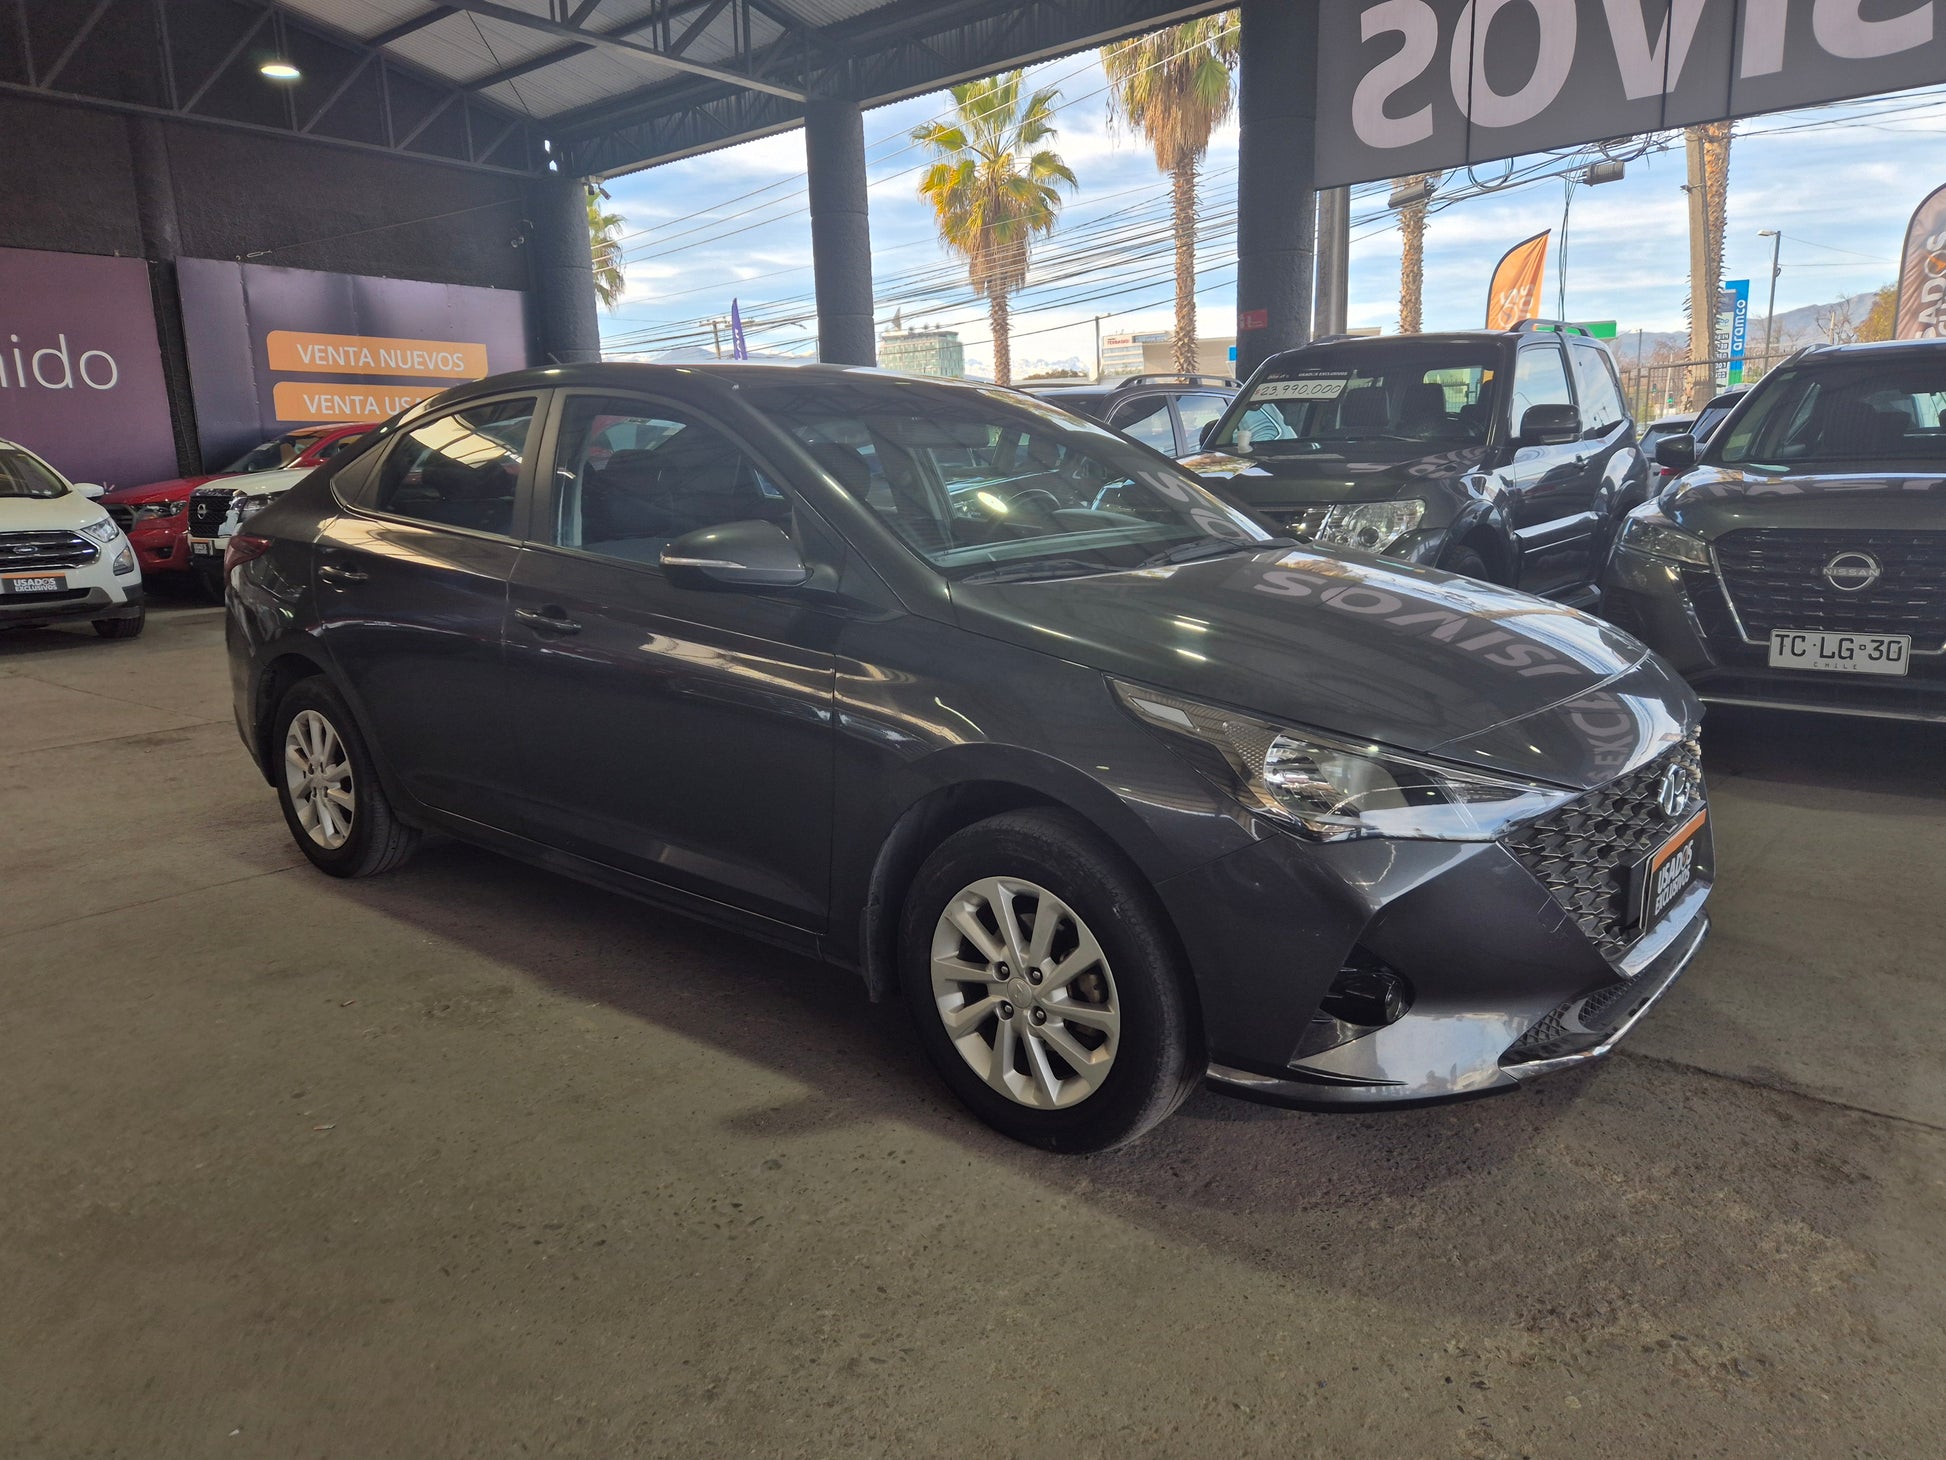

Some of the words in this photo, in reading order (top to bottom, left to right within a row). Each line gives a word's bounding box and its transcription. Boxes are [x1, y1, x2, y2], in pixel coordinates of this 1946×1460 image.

[1733, 299, 1746, 351] aramco
[297, 344, 375, 367] VENTA
[379, 349, 465, 371] NUEVOS
[303, 394, 380, 415] VENTA
[385, 397, 419, 416] US
[13, 577, 56, 586] USADOS
[1823, 568, 1880, 577] NISSAN
[15, 584, 58, 592] EXCLUSIVOS
[1813, 662, 1857, 670] CHILE
[1657, 839, 1694, 894] USADOS
[1654, 864, 1691, 916] EXCLUSIVOS
